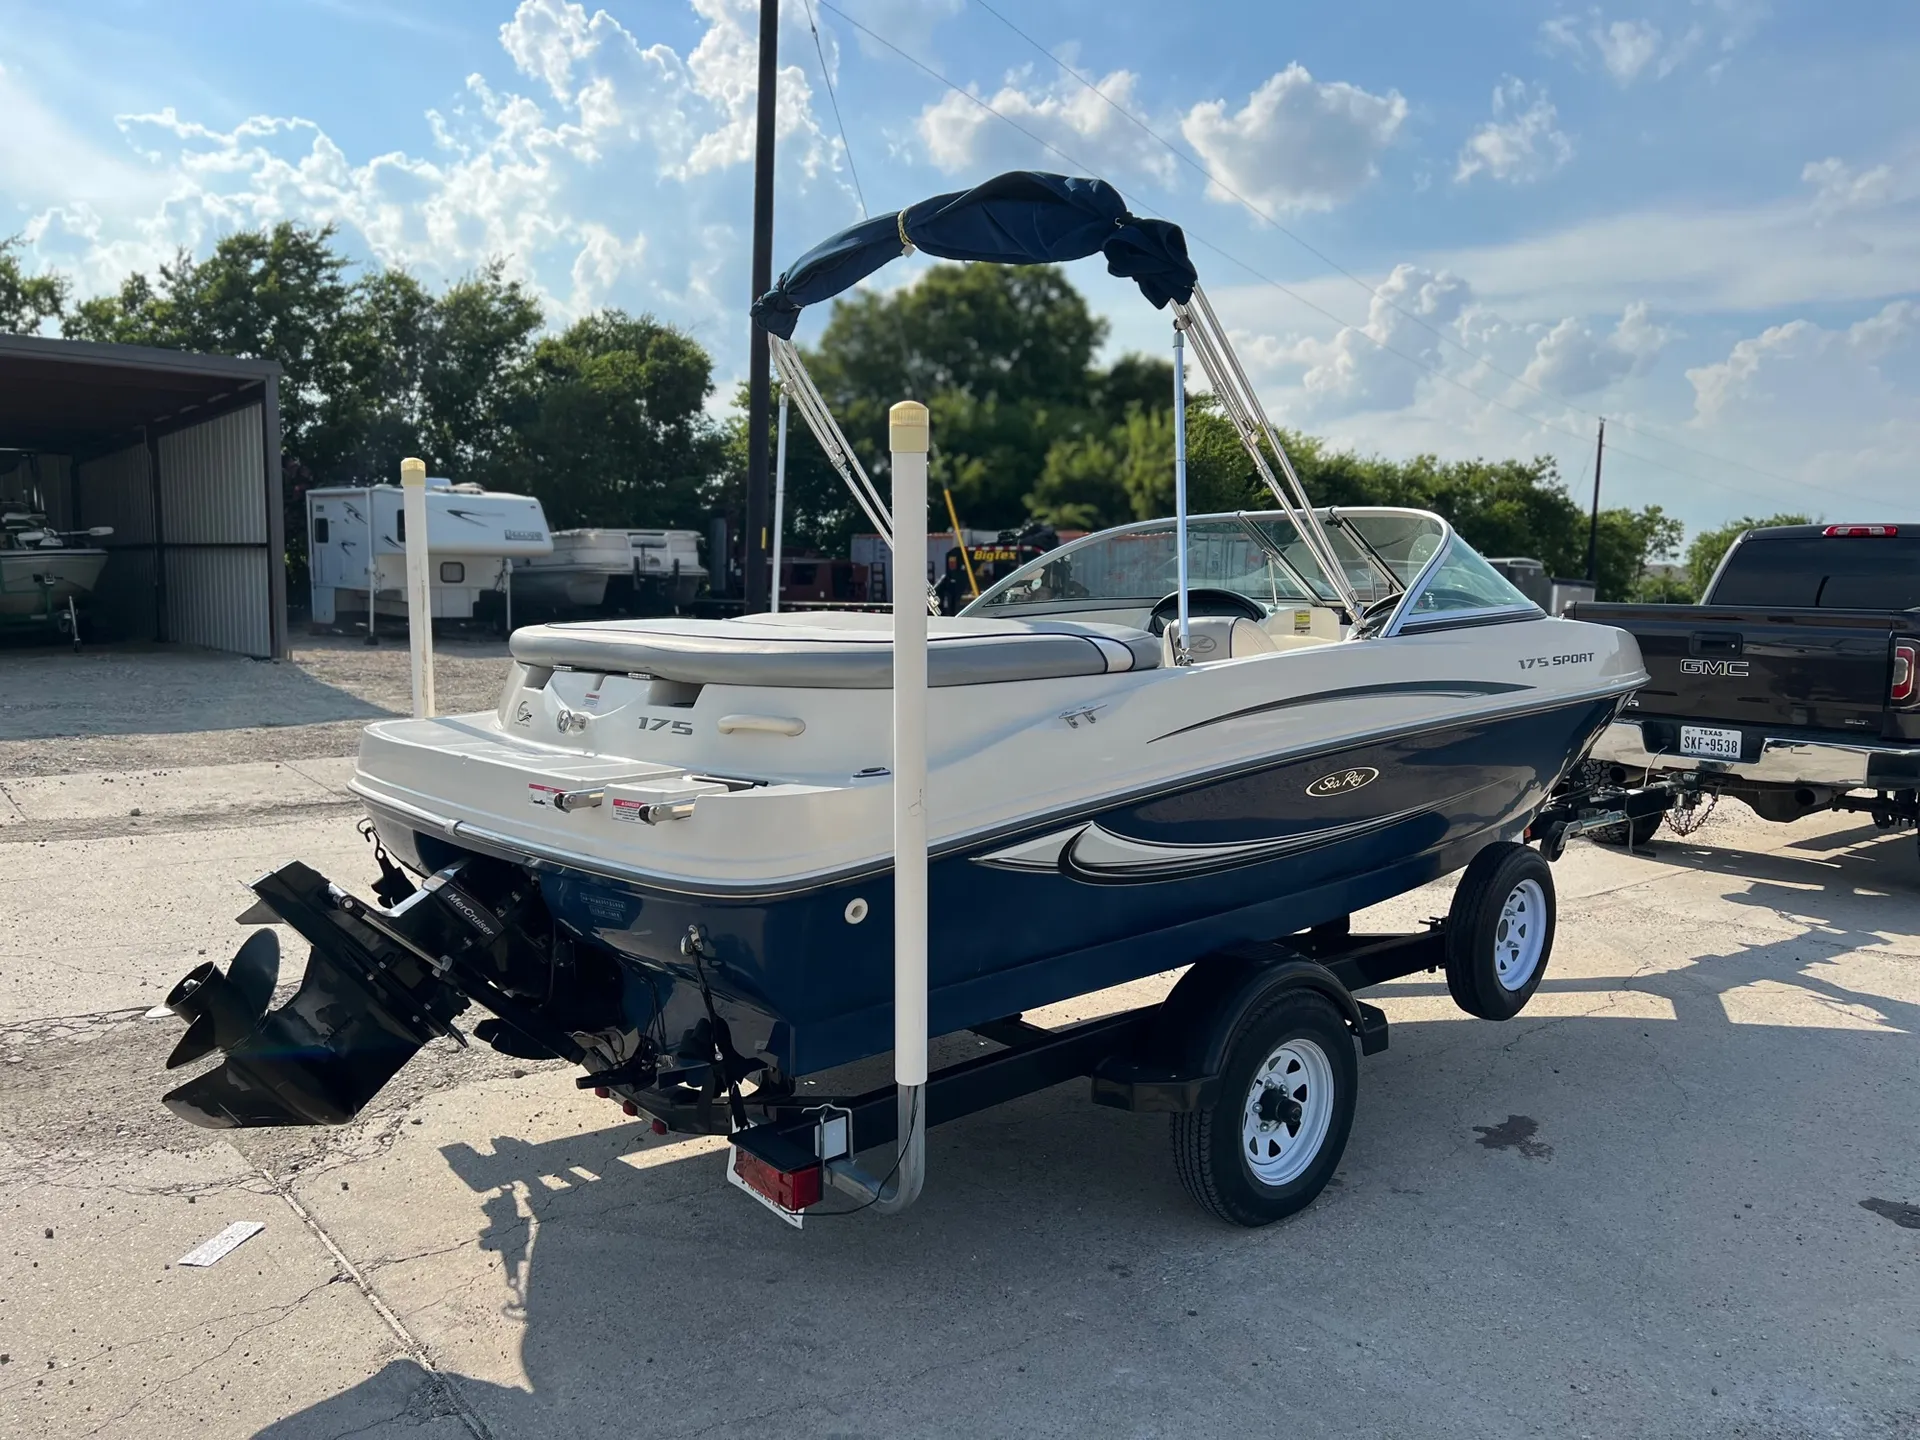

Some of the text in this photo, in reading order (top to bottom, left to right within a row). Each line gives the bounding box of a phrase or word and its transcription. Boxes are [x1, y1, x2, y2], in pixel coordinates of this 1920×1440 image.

[1518, 652, 1594, 669] 175 SPORT
[1681, 659, 1749, 676] GMC
[638, 716, 693, 735] 175
[1319, 770, 1365, 790] Sea Ray
[447, 893, 494, 935] MerCruiser
